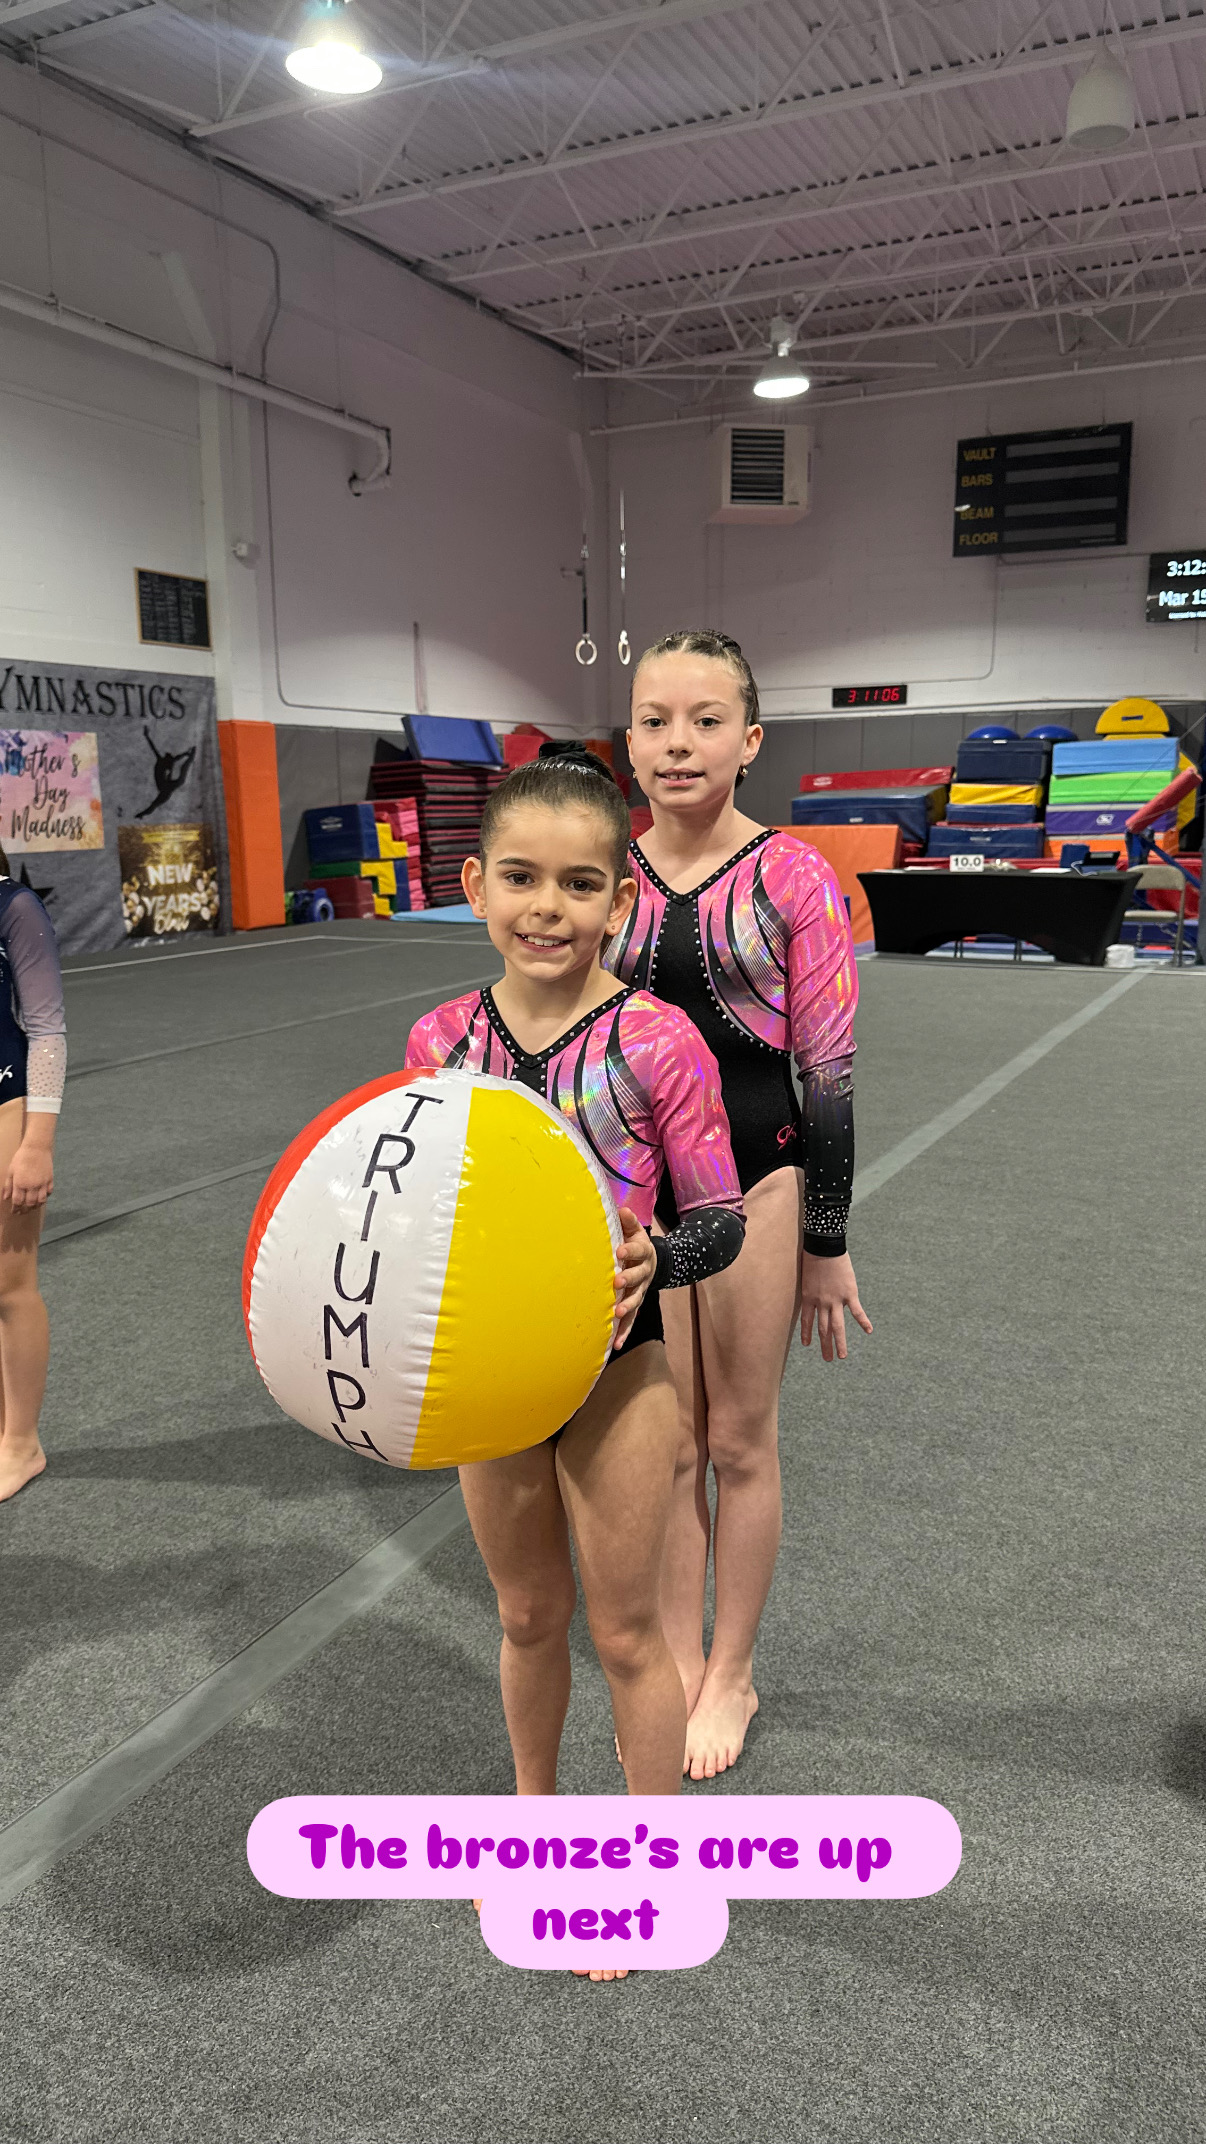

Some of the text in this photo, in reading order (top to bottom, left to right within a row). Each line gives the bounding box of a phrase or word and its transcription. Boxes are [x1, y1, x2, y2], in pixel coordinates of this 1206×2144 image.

[963, 447, 996, 461] VAULT
[961, 473, 993, 488] BARS
[960, 506, 994, 520] BEAM
[959, 532, 999, 546] FLOOR
[1159, 590, 1189, 607] Mar
[32, 775, 71, 813] Day
[11, 803, 86, 843] Madness
[954, 857, 981, 867] 10.0
[146, 863, 193, 886] NEW
[141, 892, 201, 917] YEARS
[322, 1092, 444, 1462] TRIUMPH
